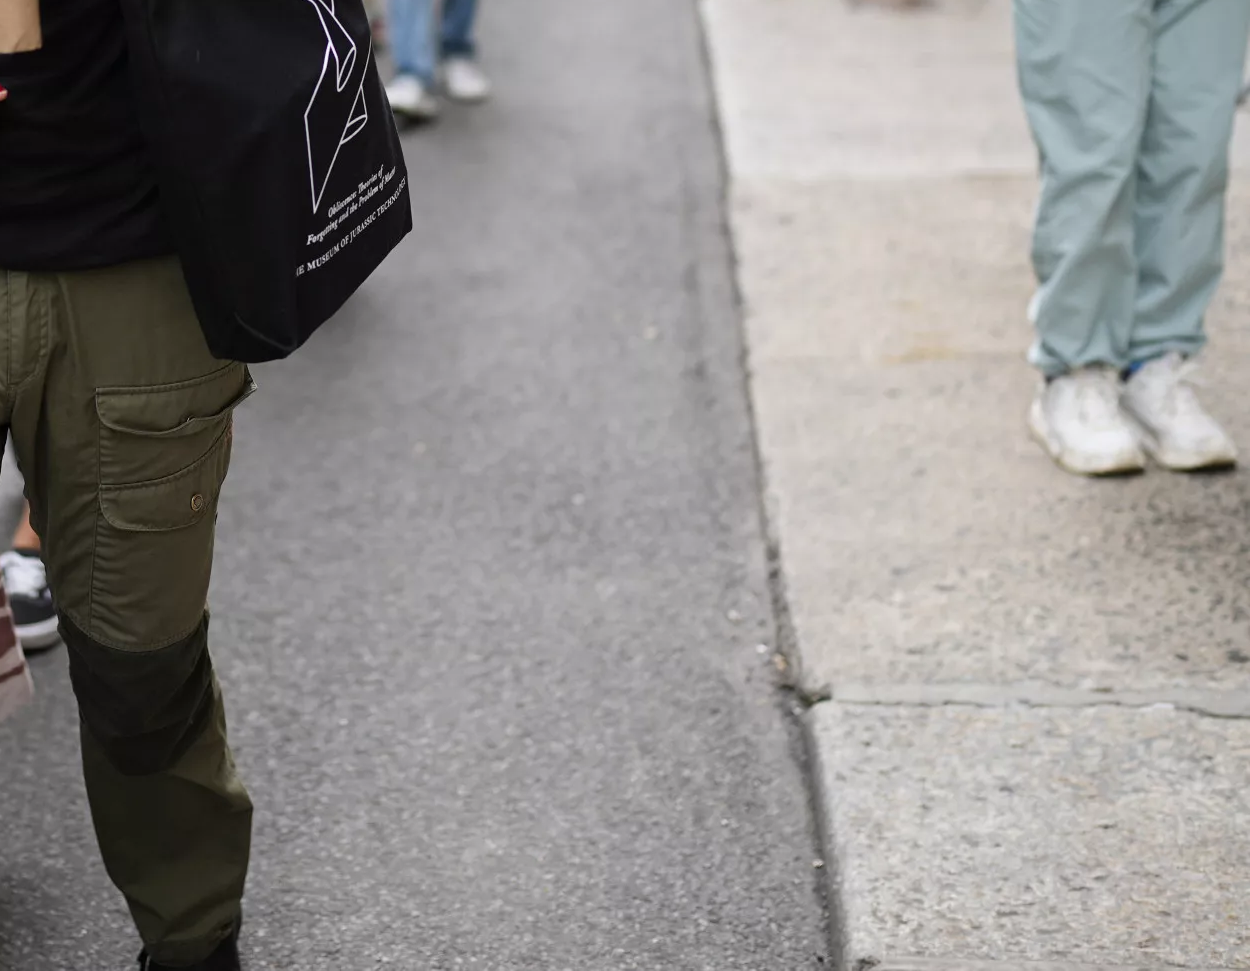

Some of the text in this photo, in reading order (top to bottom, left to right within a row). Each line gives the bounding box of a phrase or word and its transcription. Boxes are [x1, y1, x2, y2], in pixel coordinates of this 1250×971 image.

[377, 164, 384, 182] of
[306, 219, 338, 245] Forgetting
[338, 206, 350, 223] and
[350, 202, 358, 215] the
[358, 185, 379, 207] Problem
[307, 243, 340, 271] MUSEUM
[340, 235, 350, 248] OF
[350, 212, 377, 243] JURASSIC
